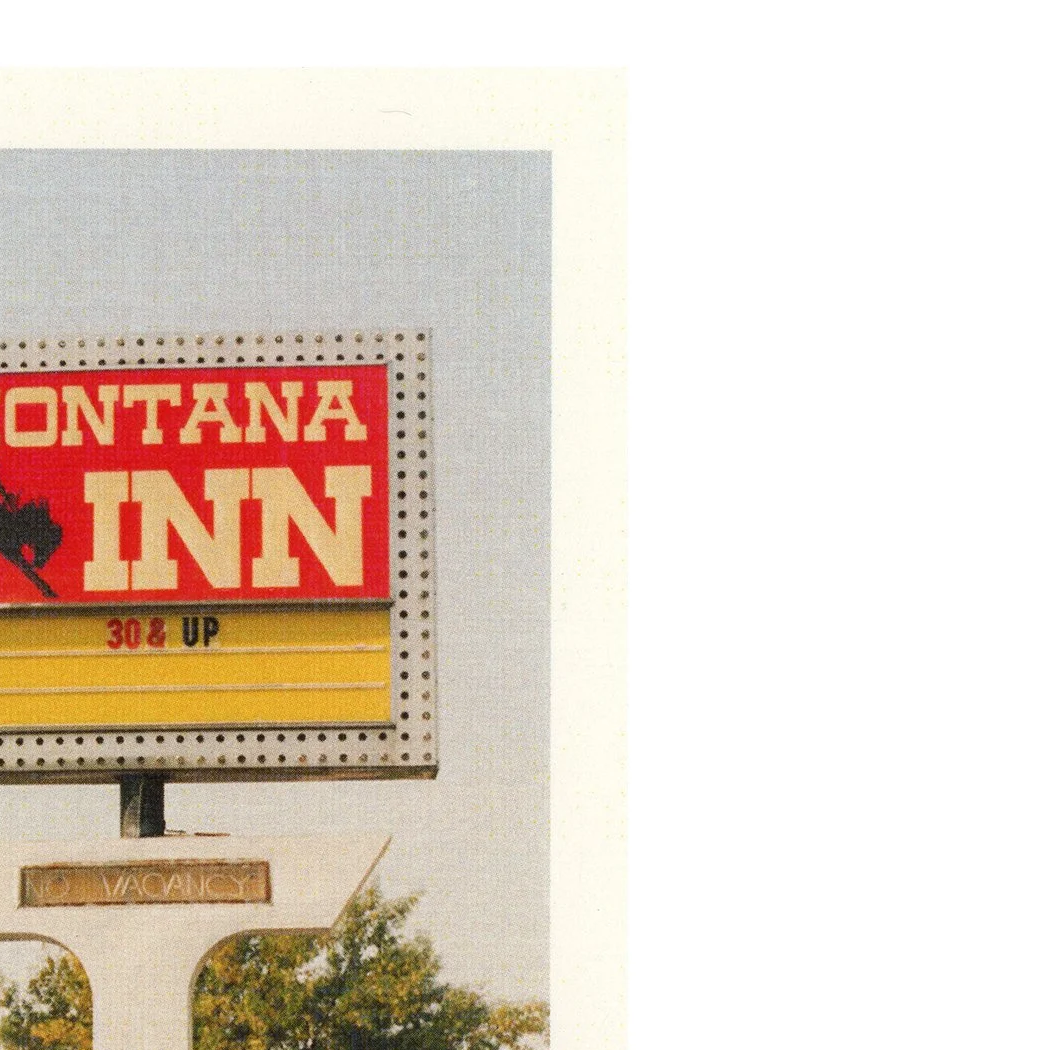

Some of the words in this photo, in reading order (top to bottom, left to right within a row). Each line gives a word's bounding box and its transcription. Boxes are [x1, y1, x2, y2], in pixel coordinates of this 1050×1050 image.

[83, 465, 373, 592] INN
[182, 615, 220, 647] UP
[25, 873, 70, 898] NO
[100, 872, 251, 898] VACANCY
